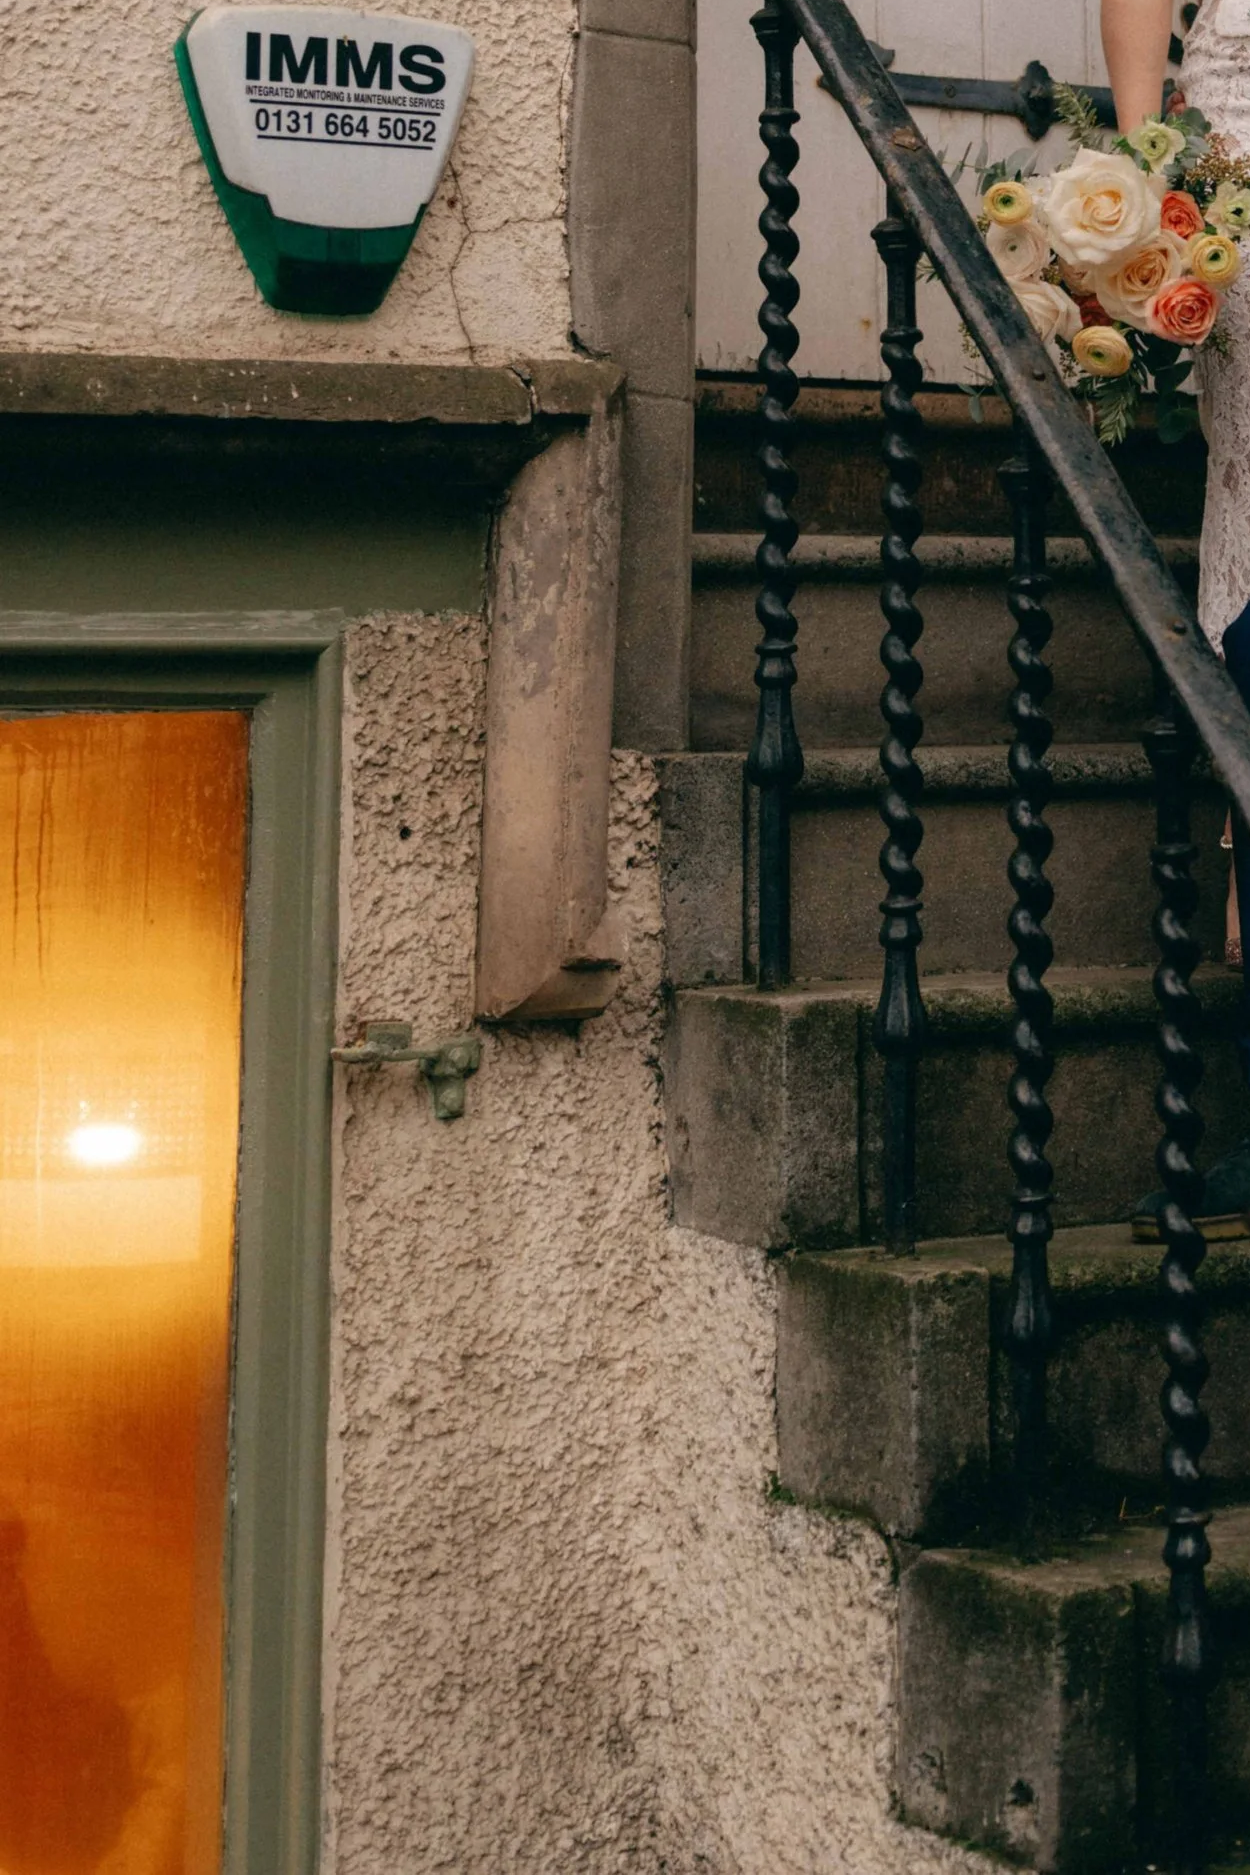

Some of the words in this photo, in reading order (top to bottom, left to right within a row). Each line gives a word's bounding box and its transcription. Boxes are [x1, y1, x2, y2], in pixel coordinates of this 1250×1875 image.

[246, 31, 446, 95] IMMS
[246, 85, 295, 98] INTEGRATED
[296, 89, 345, 103] MONITORING
[347, 93, 352, 103] &
[354, 94, 407, 107] MAINTENANCE
[409, 98, 445, 110] SERVICES
[255, 108, 313, 134] 0131
[325, 113, 370, 138] 664
[378, 117, 436, 143] 5052
